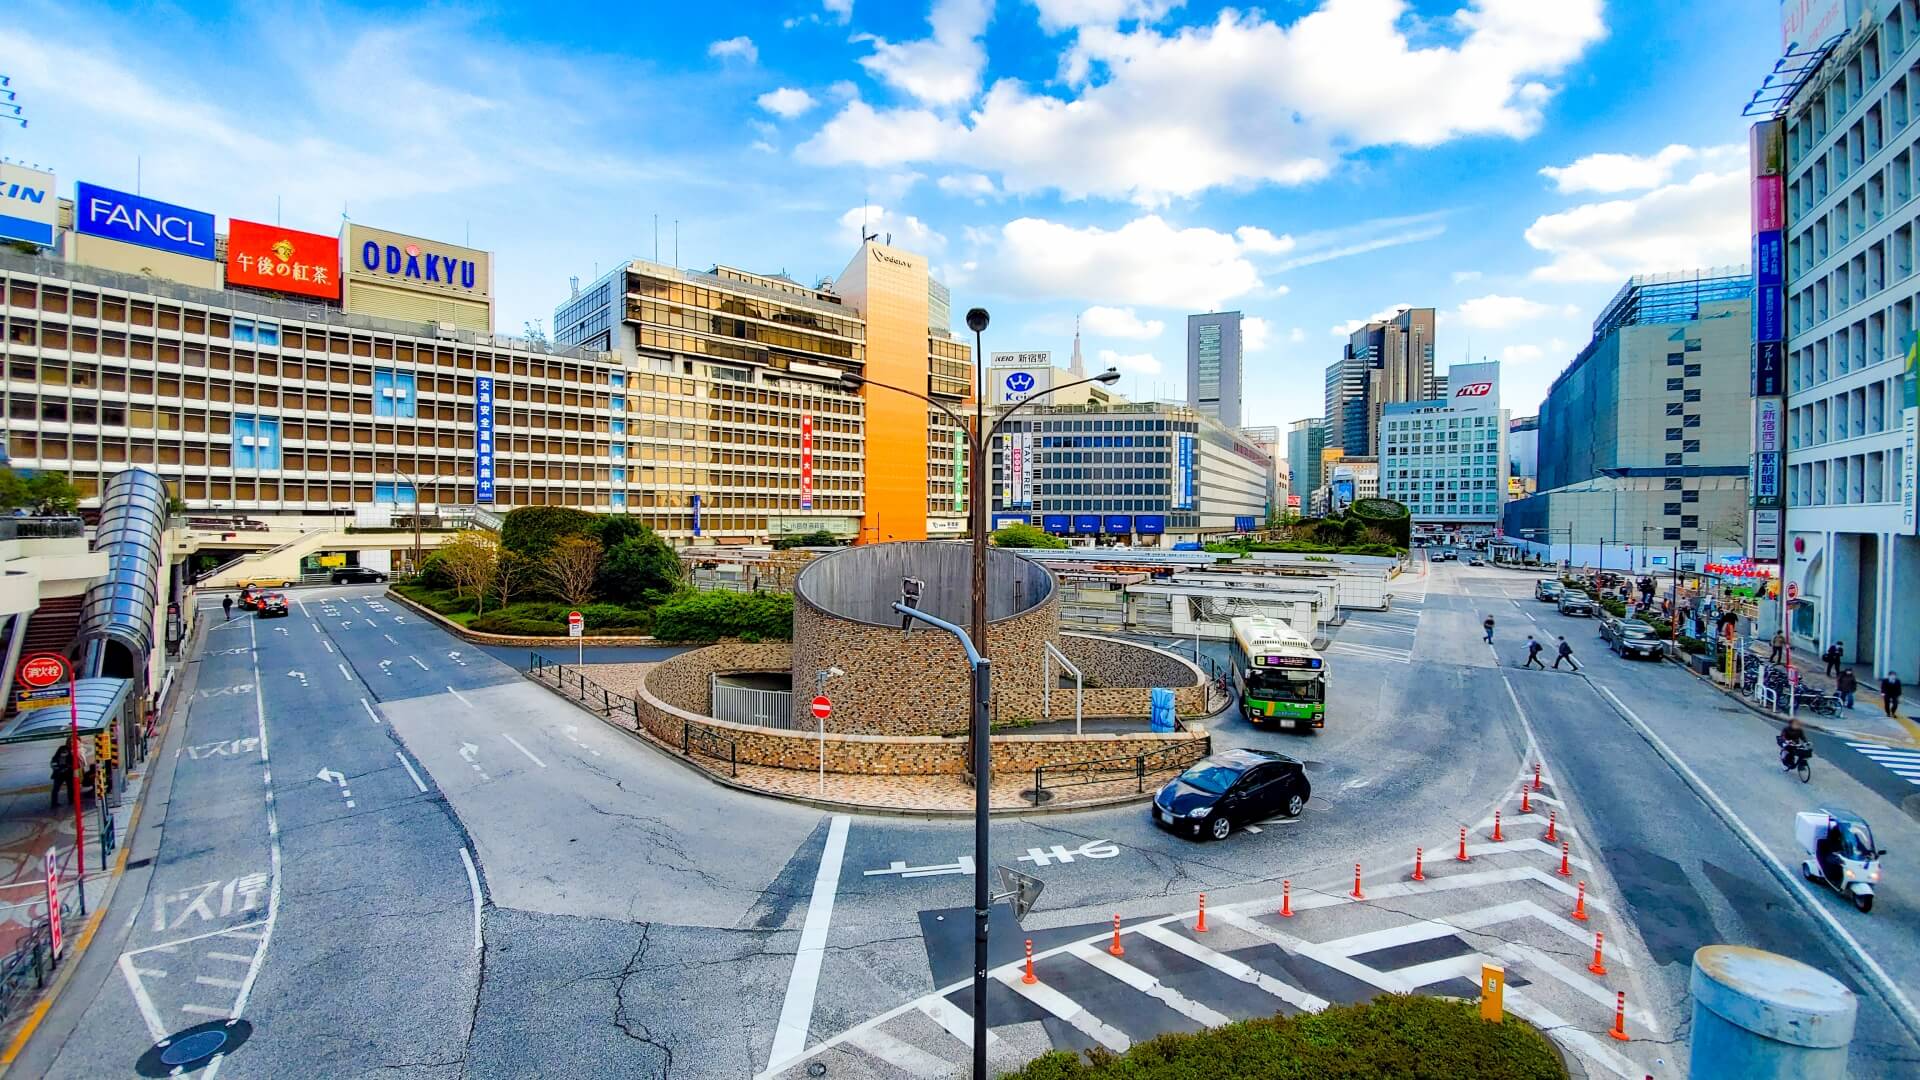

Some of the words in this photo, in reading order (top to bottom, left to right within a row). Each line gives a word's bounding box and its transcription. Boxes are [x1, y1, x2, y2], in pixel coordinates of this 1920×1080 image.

[90, 198, 205, 246] FANCL
[237, 253, 329, 284] 午後の紅茶
[363, 241, 475, 288] ODAKYU
[1019, 353, 1047, 363] 新宿駅
[1006, 392, 1031, 402] Kei
[1760, 497, 1776, 505] 4F
[27, 666, 59, 678] 消火栓
